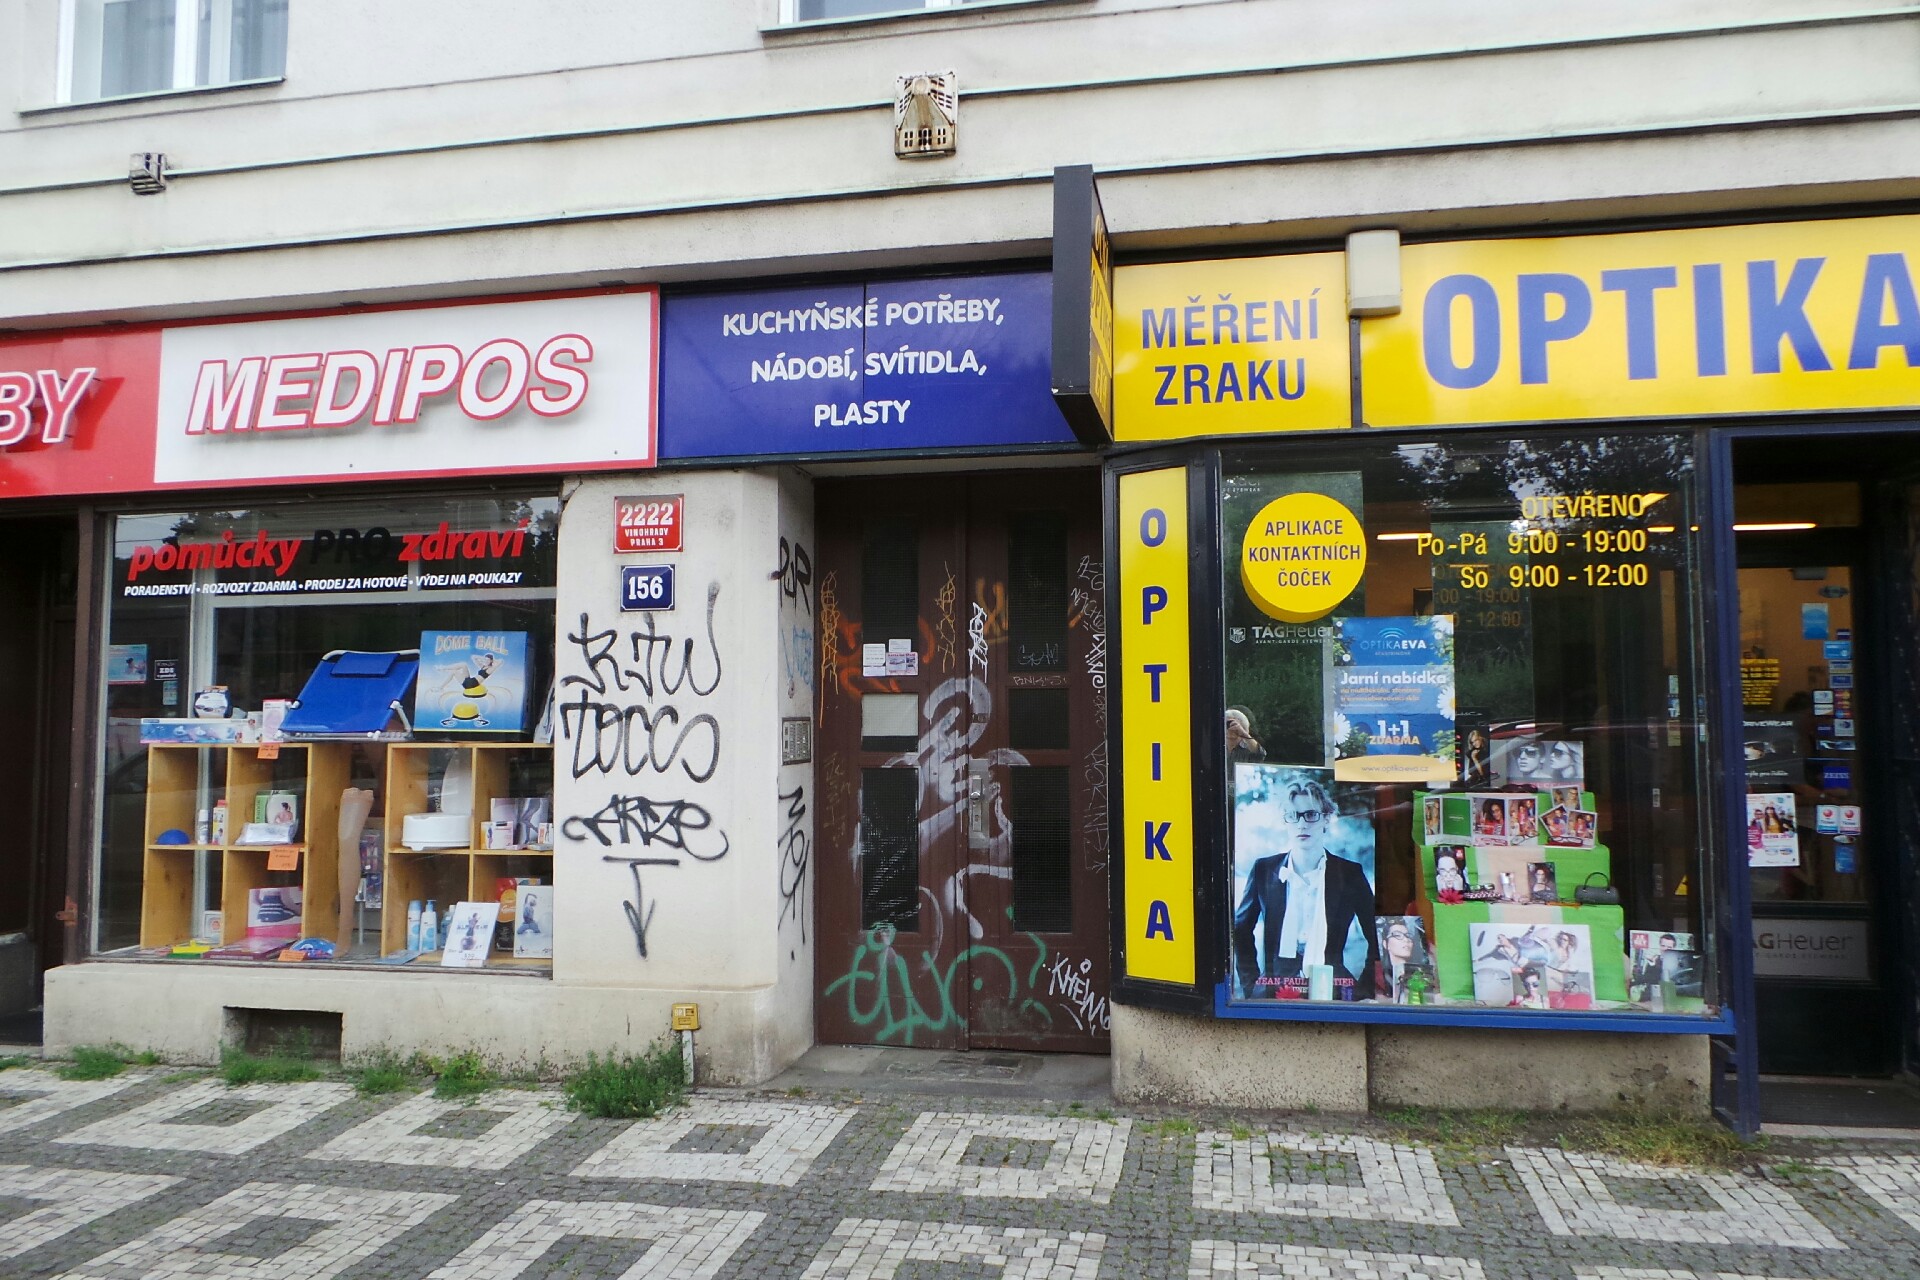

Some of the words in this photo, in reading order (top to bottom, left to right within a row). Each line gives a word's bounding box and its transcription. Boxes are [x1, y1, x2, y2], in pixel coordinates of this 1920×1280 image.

[723, 297, 879, 336] KUCHYŇSKÉ
[886, 293, 1004, 326] POTŘEBY,
[1142, 288, 1321, 349] MĚŘENÍ
[1422, 253, 1920, 391] OPTIKA
[752, 348, 858, 382] NÁDOBÍ,
[865, 345, 987, 375] SVÍTIDLA,
[185, 334, 594, 436] MEDIPOS
[1154, 357, 1306, 406] ZRAKU
[815, 400, 910, 427] PLASTY
[620, 503, 674, 527] 2222
[1521, 491, 1644, 519] OTEVŘENO
[624, 528, 669, 537] VINOHRADY
[1265, 520, 1344, 536] APLIKACE
[127, 530, 303, 581] pomůcky
[312, 528, 392, 566] PRO
[398, 518, 530, 562] zdraví
[630, 538, 656, 547] PRAHA
[658, 538, 664, 546] 3
[1249, 542, 1361, 562] KONTAKTNÍCH
[1508, 530, 1558, 554] 9:00
[1582, 529, 1647, 553] 19:00
[124, 583, 196, 597] PORADENSTVÍ
[202, 581, 251, 594] ROZVOZY
[251, 580, 298, 592] ZDARMA
[304, 577, 347, 591] PRODEJ
[347, 577, 362, 589] ZA
[363, 573, 408, 588] HOTOVÉ
[415, 572, 451, 587] VÝDEJ
[451, 574, 466, 585] NA
[470, 571, 523, 585] POUKAZY
[628, 576, 662, 600] 156
[1278, 568, 1332, 587] ČOČEK
[1460, 566, 1489, 588] So
[1508, 565, 1560, 587] 9:00
[1583, 564, 1649, 586] 12:00
[435, 635, 471, 655] DOME
[475, 635, 509, 655] BALL
[1340, 670, 1379, 685] Jarní
[1382, 670, 1447, 685] nabídka
[1140, 508, 1174, 941] OPTIKA
[1377, 719, 1411, 740] 1+1
[1369, 735, 1421, 746] ZDARMA
[1256, 977, 1282, 986] JEAN
[1284, 977, 1308, 986] PAUL
